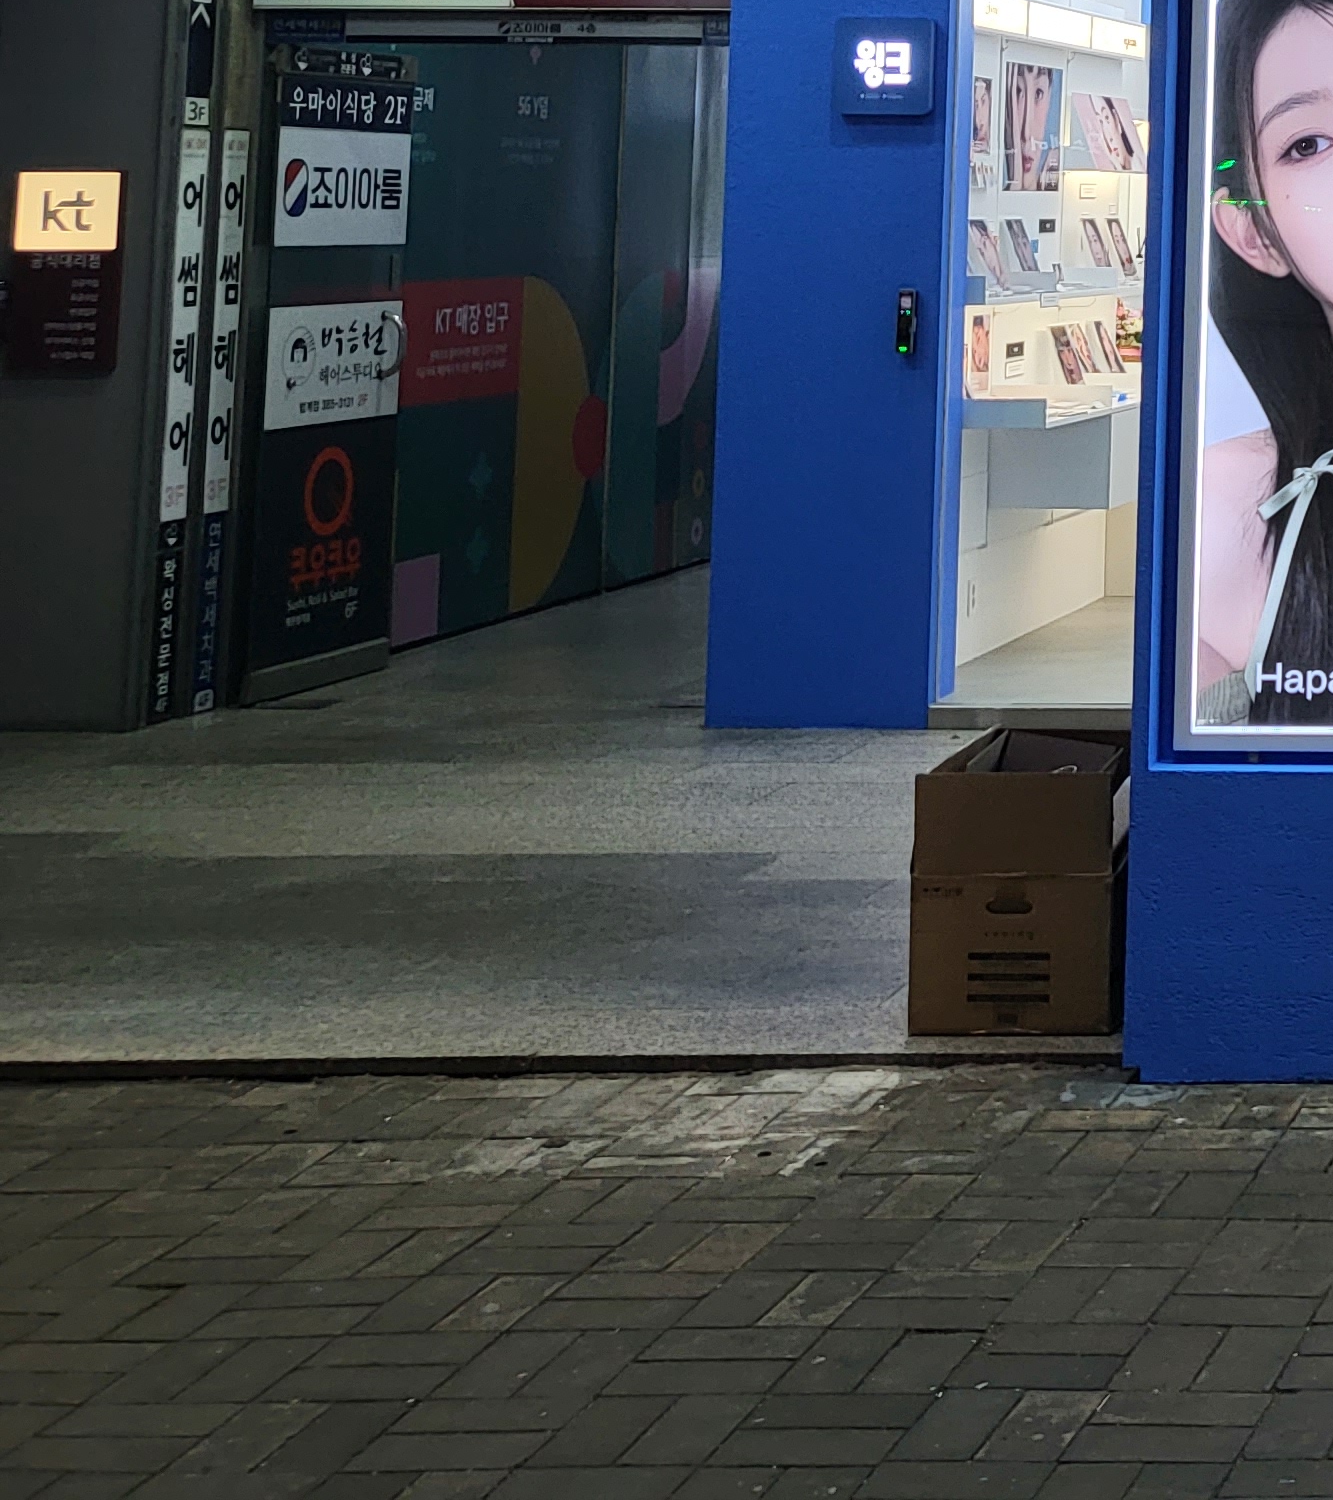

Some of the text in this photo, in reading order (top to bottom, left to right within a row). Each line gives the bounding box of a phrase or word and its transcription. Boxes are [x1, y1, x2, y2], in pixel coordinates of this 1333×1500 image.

[853, 39, 912, 89] 윙크
[188, 101, 206, 121] 3F
[289, 86, 408, 125] 우마이식당 2F
[517, 96, 532, 116] 5G
[309, 167, 403, 211] 죠이아룸
[41, 190, 96, 232] kt
[168, 173, 206, 467] 어썸헤어
[210, 173, 246, 461] 어썸헤어
[435, 301, 510, 336] KT 매장 입구
[322, 319, 388, 357] 박승철
